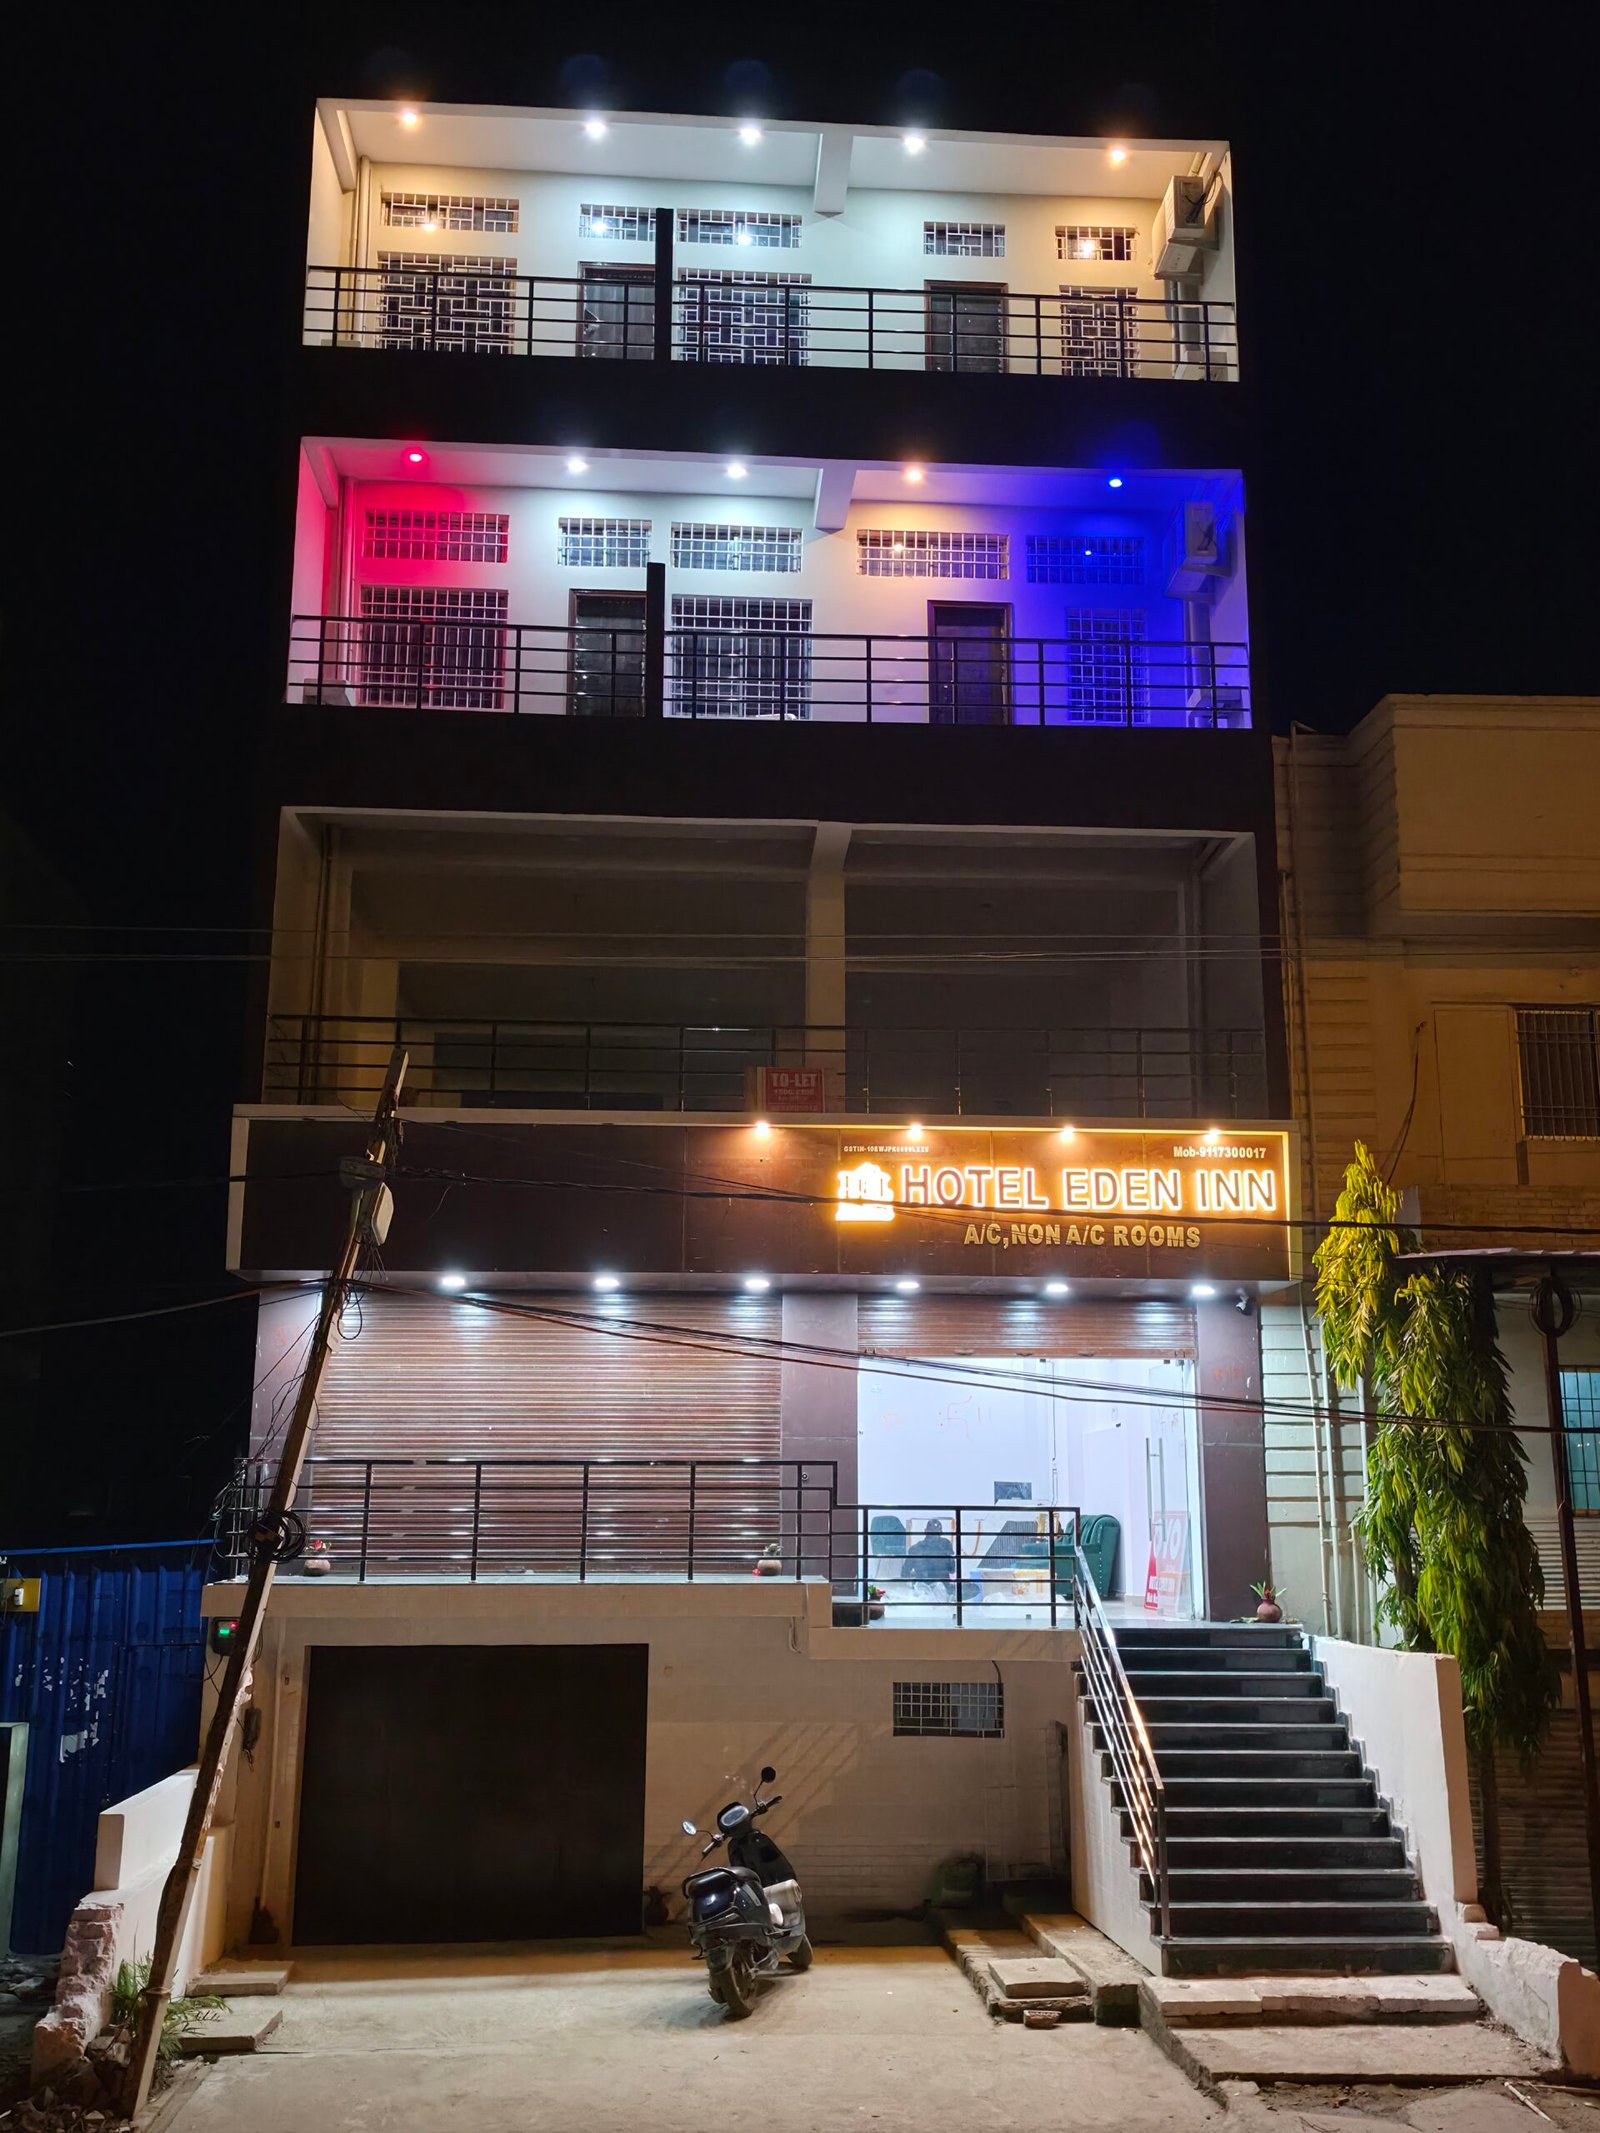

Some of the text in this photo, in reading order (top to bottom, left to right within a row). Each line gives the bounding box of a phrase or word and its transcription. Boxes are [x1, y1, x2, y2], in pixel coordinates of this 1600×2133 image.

[770, 1073, 817, 1087] TO-LET
[1173, 1146, 1267, 1158] Mob-9117300017
[900, 1165, 1277, 1212] HOTEL EDEN INN
[1065, 1225, 1105, 1246] A/C
[1113, 1225, 1201, 1247] ROOMS
